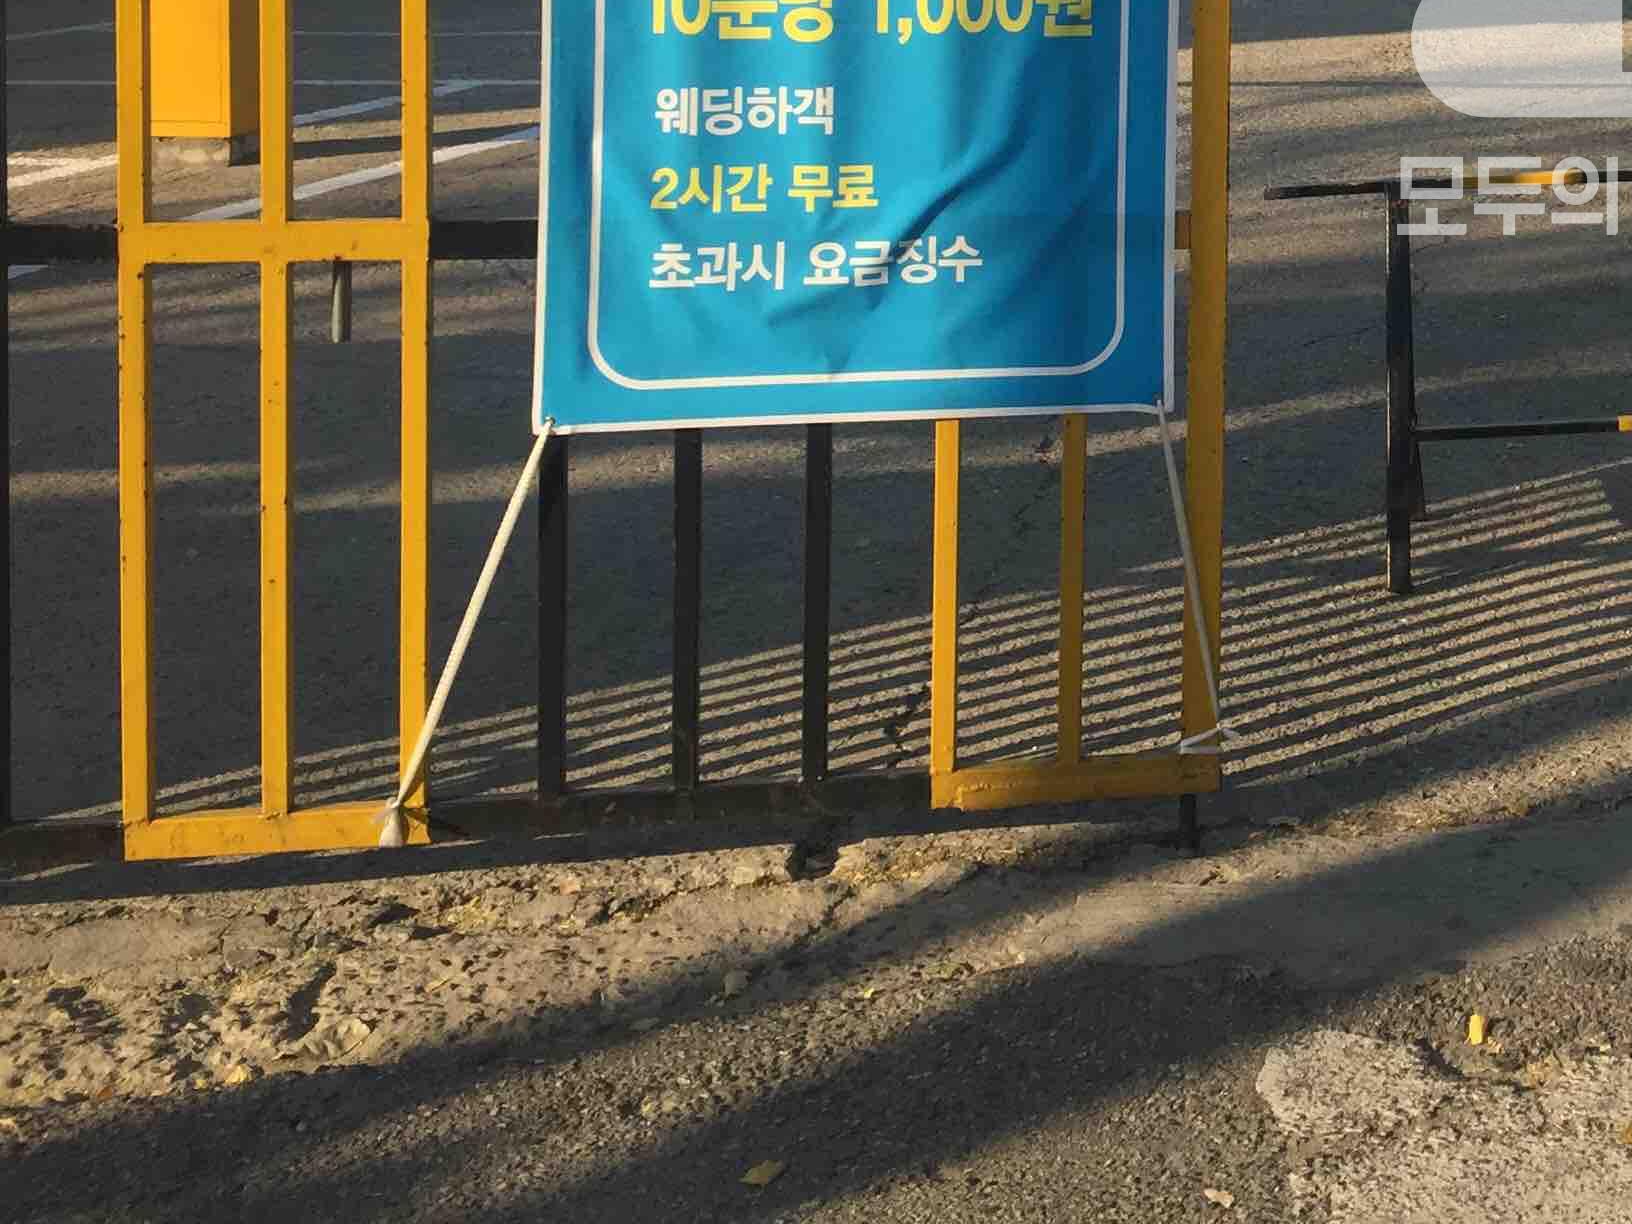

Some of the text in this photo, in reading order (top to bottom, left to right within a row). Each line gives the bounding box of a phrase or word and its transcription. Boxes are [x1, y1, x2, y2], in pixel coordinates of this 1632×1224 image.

[655, 86, 834, 136] 웨딩하객
[649, 164, 879, 214] 2시간 무료
[648, 235, 983, 291] 초과시 요금징수
